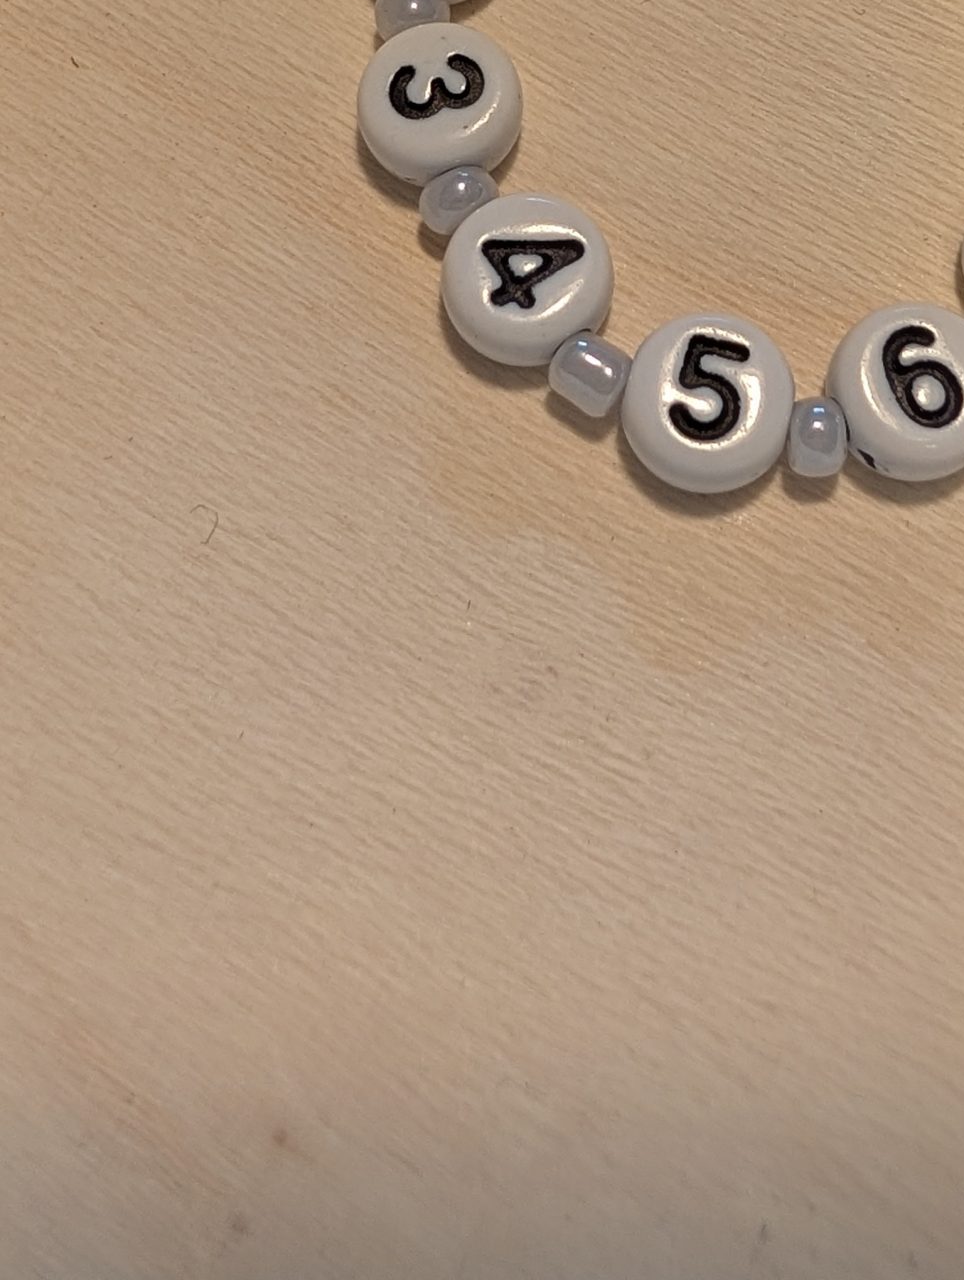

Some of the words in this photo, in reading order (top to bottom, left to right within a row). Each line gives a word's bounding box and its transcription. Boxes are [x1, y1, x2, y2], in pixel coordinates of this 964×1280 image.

[388, 53, 486, 122] 3
[481, 237, 586, 311] 4
[667, 333, 752, 443] 5
[881, 324, 964, 430] 6
